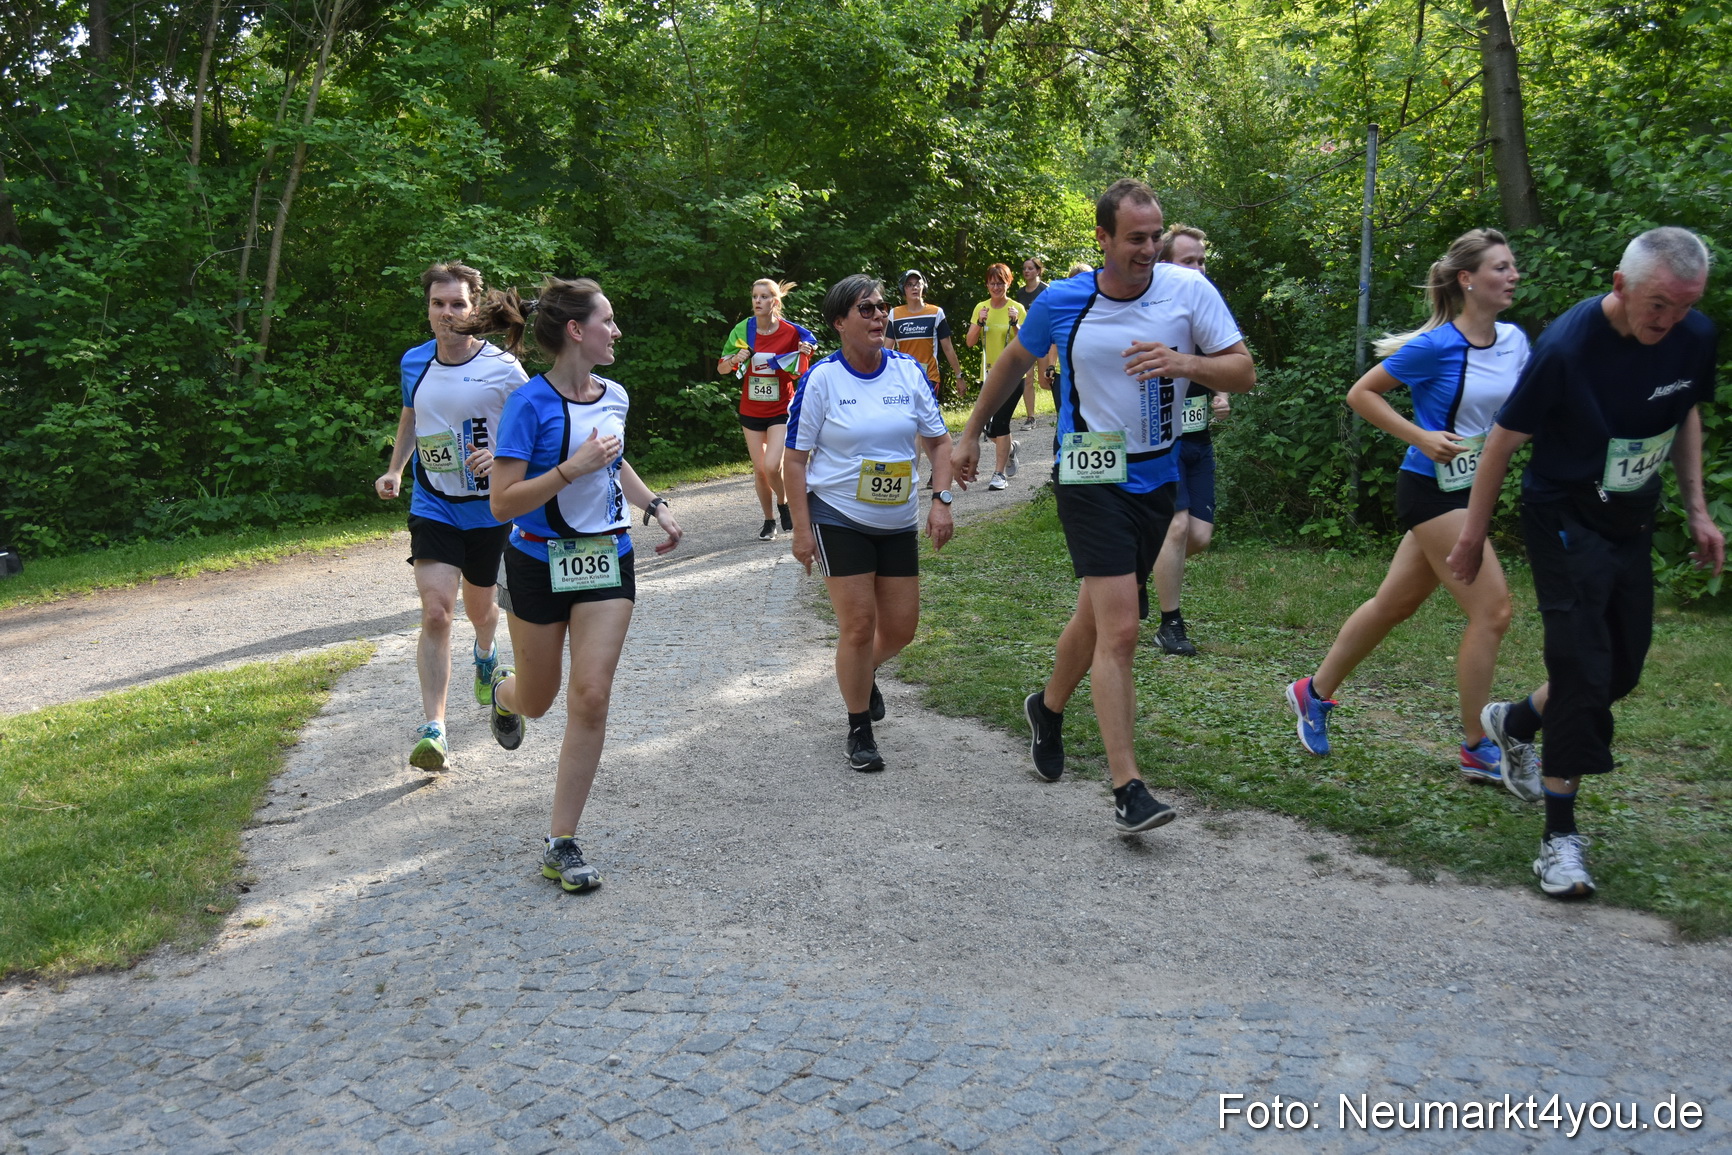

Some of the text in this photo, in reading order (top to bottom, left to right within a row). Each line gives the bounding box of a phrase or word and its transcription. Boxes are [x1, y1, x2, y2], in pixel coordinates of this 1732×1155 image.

[902, 322, 928, 332] Fischer
[754, 385, 772, 395] 548
[839, 398, 857, 406] JAKO
[1140, 394, 1148, 417] WATER
[1150, 377, 1158, 442] ECHNOLOGY
[1182, 408, 1205, 423] 1867
[421, 447, 452, 463] 054
[472, 417, 489, 492] HUR
[1067, 450, 1116, 470] 1039
[871, 477, 902, 493] 934
[559, 555, 610, 576] 1036
[562, 575, 588, 583] Bergmann
